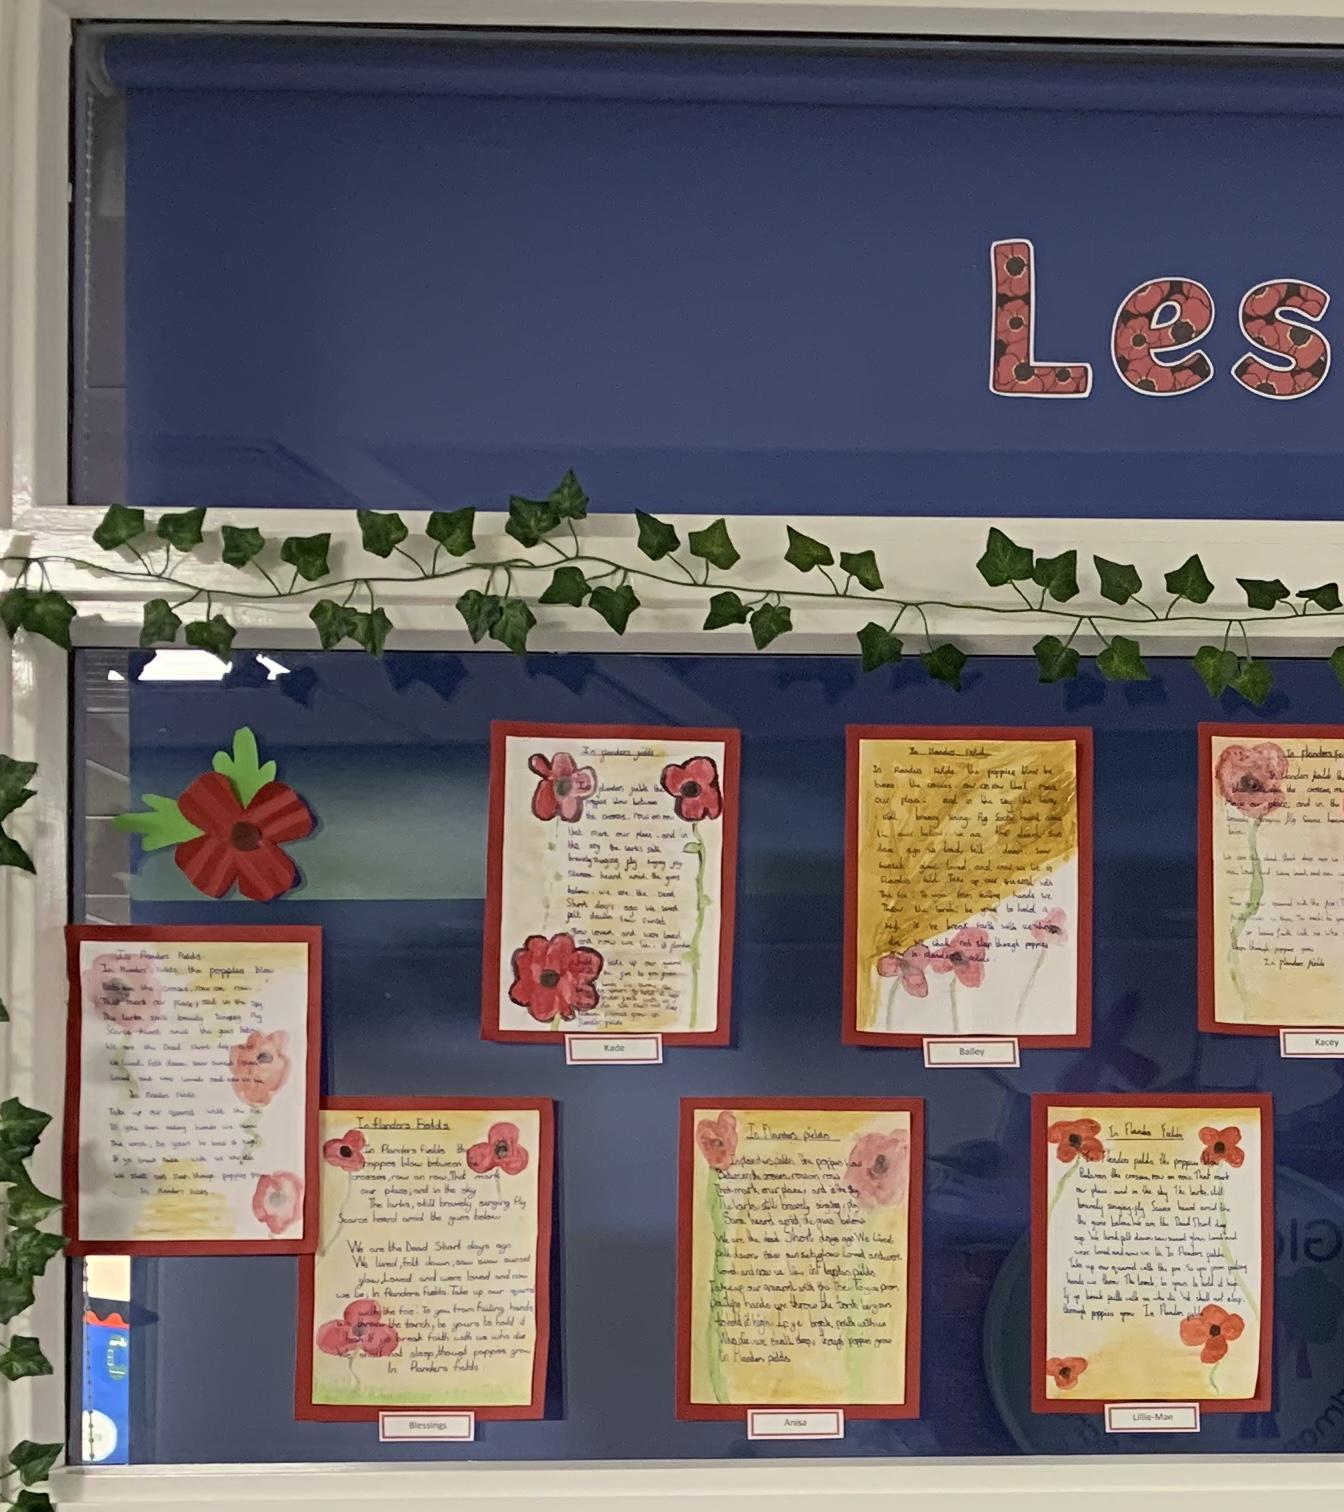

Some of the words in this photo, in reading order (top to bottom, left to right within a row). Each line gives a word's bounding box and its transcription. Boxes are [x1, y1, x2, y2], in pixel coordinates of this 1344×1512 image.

[603, 1043, 626, 1053] Kade
[1314, 1038, 1340, 1048] Kacey
[958, 1046, 986, 1057] Bailey
[1132, 1412, 1174, 1422] Lillie-Mae
[408, 1420, 448, 1431] Blessings
